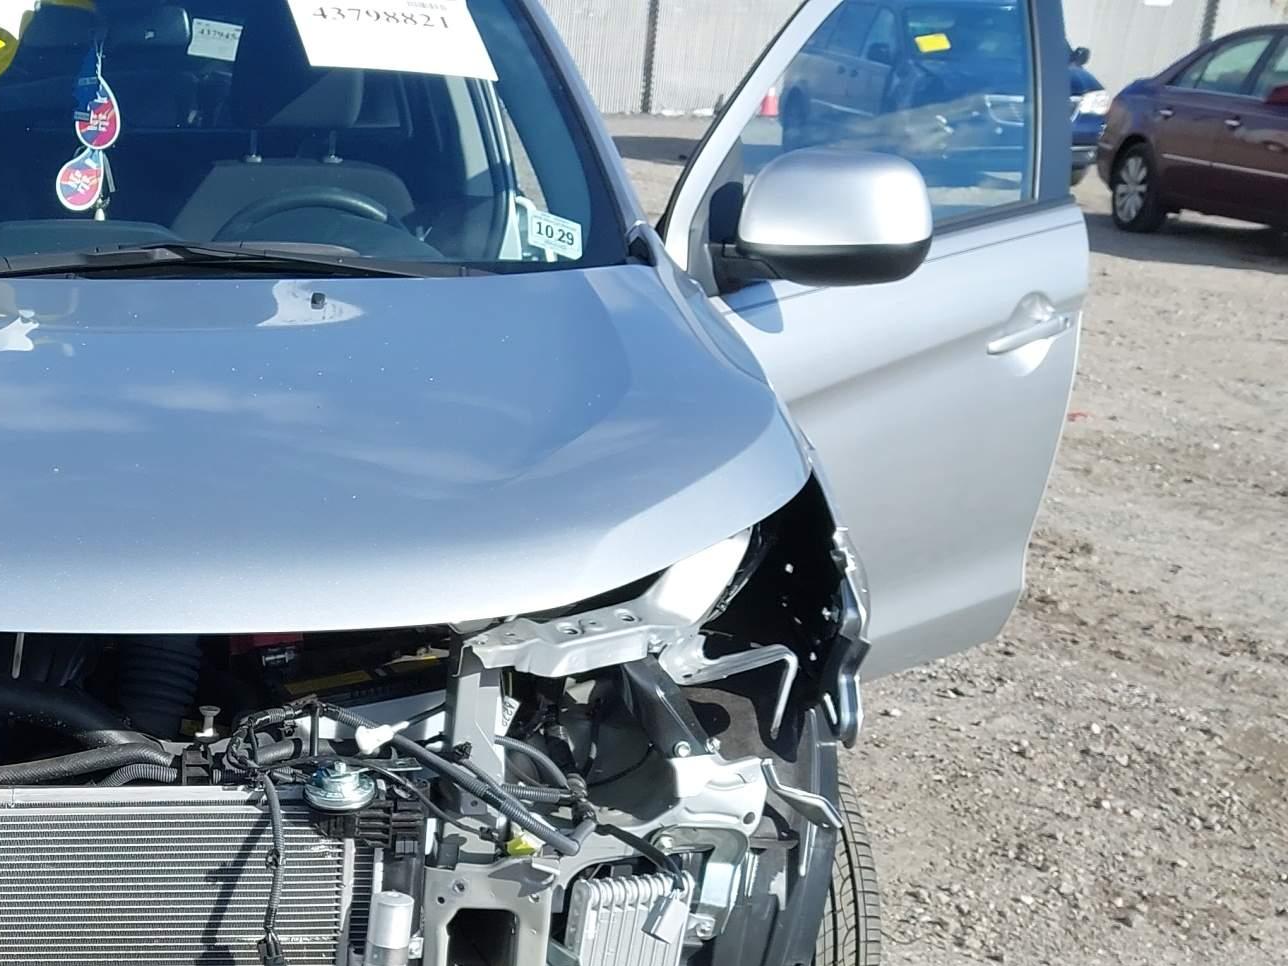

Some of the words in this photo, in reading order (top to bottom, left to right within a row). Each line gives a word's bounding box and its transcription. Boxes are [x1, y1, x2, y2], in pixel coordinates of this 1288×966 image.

[312, 6, 450, 29] 43798821
[536, 221, 554, 239] 10
[557, 228, 575, 246] 29
